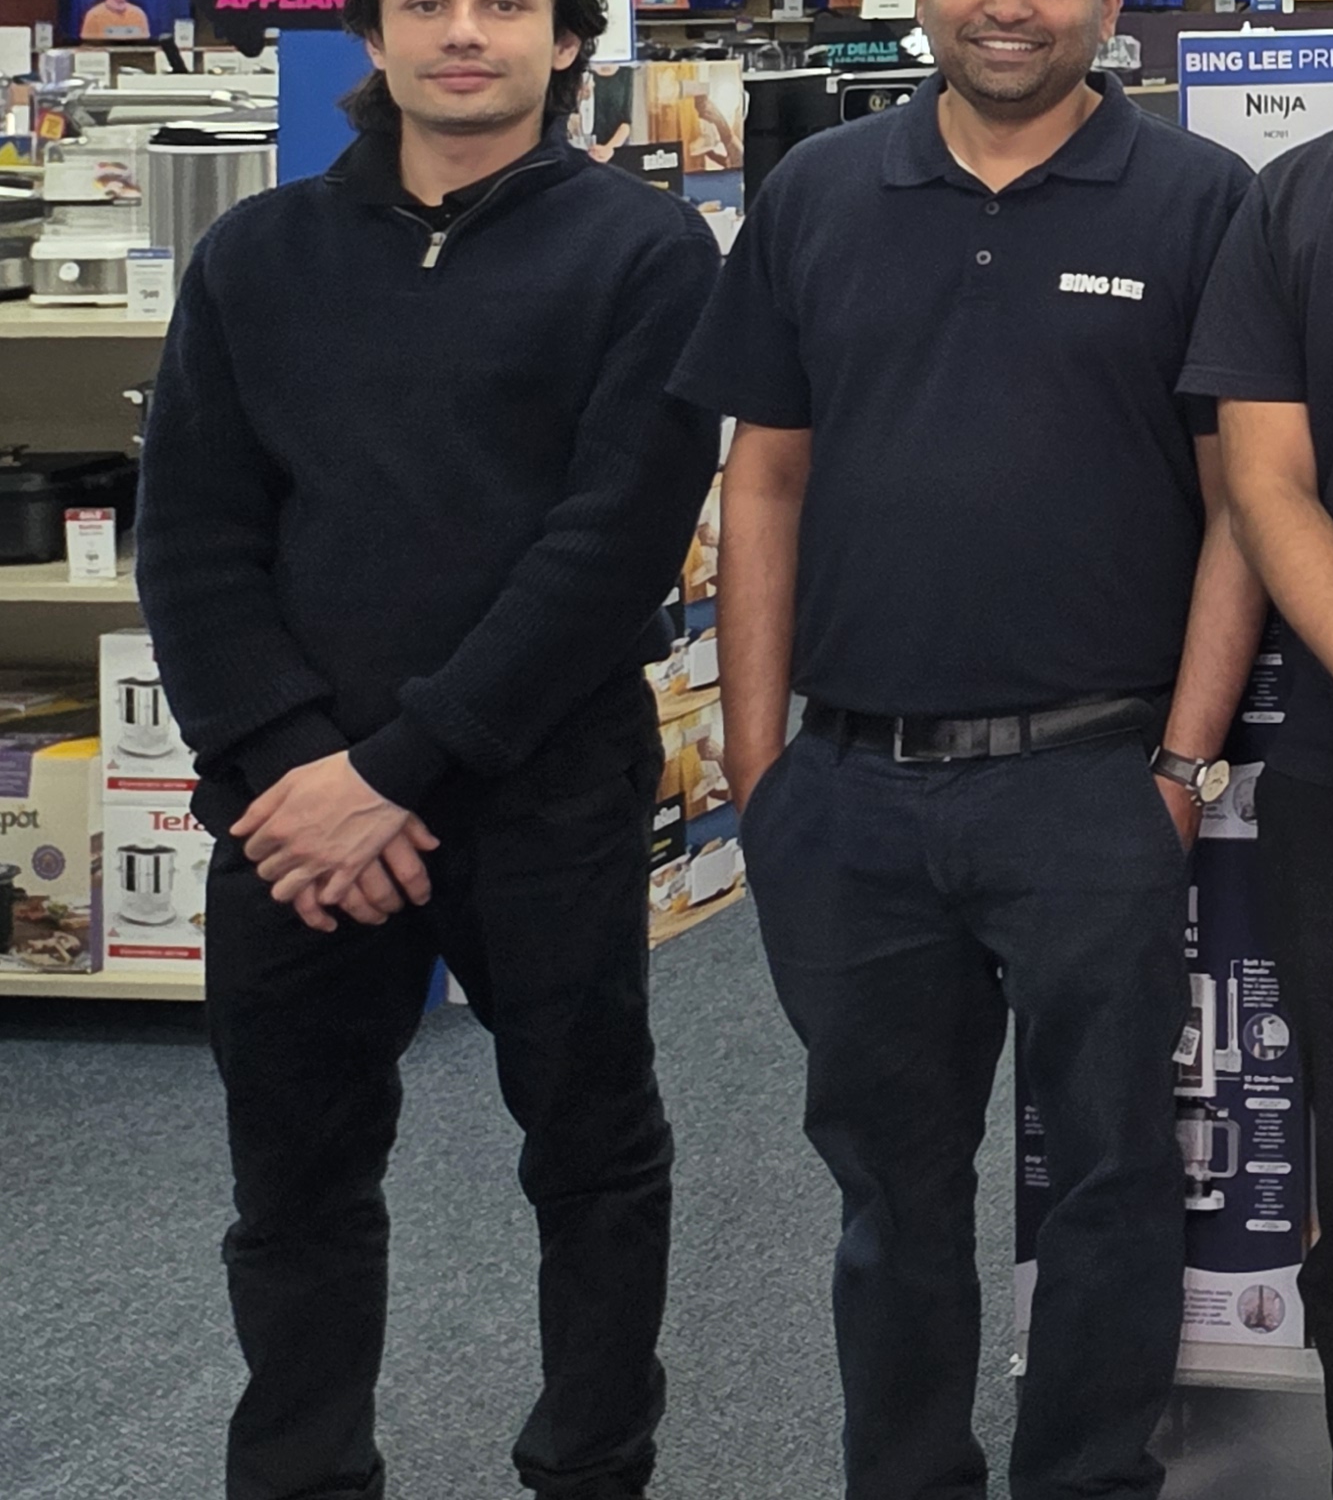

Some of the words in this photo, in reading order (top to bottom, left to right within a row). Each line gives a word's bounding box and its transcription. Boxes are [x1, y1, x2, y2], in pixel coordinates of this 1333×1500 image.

[827, 44, 845, 56] OT
[847, 41, 898, 54] DEALS
[1186, 52, 1243, 72] BING
[1249, 50, 1292, 70] LEE
[1059, 272, 1110, 296] BING
[1111, 276, 1145, 300] LEE
[148, 811, 206, 831] Tef
